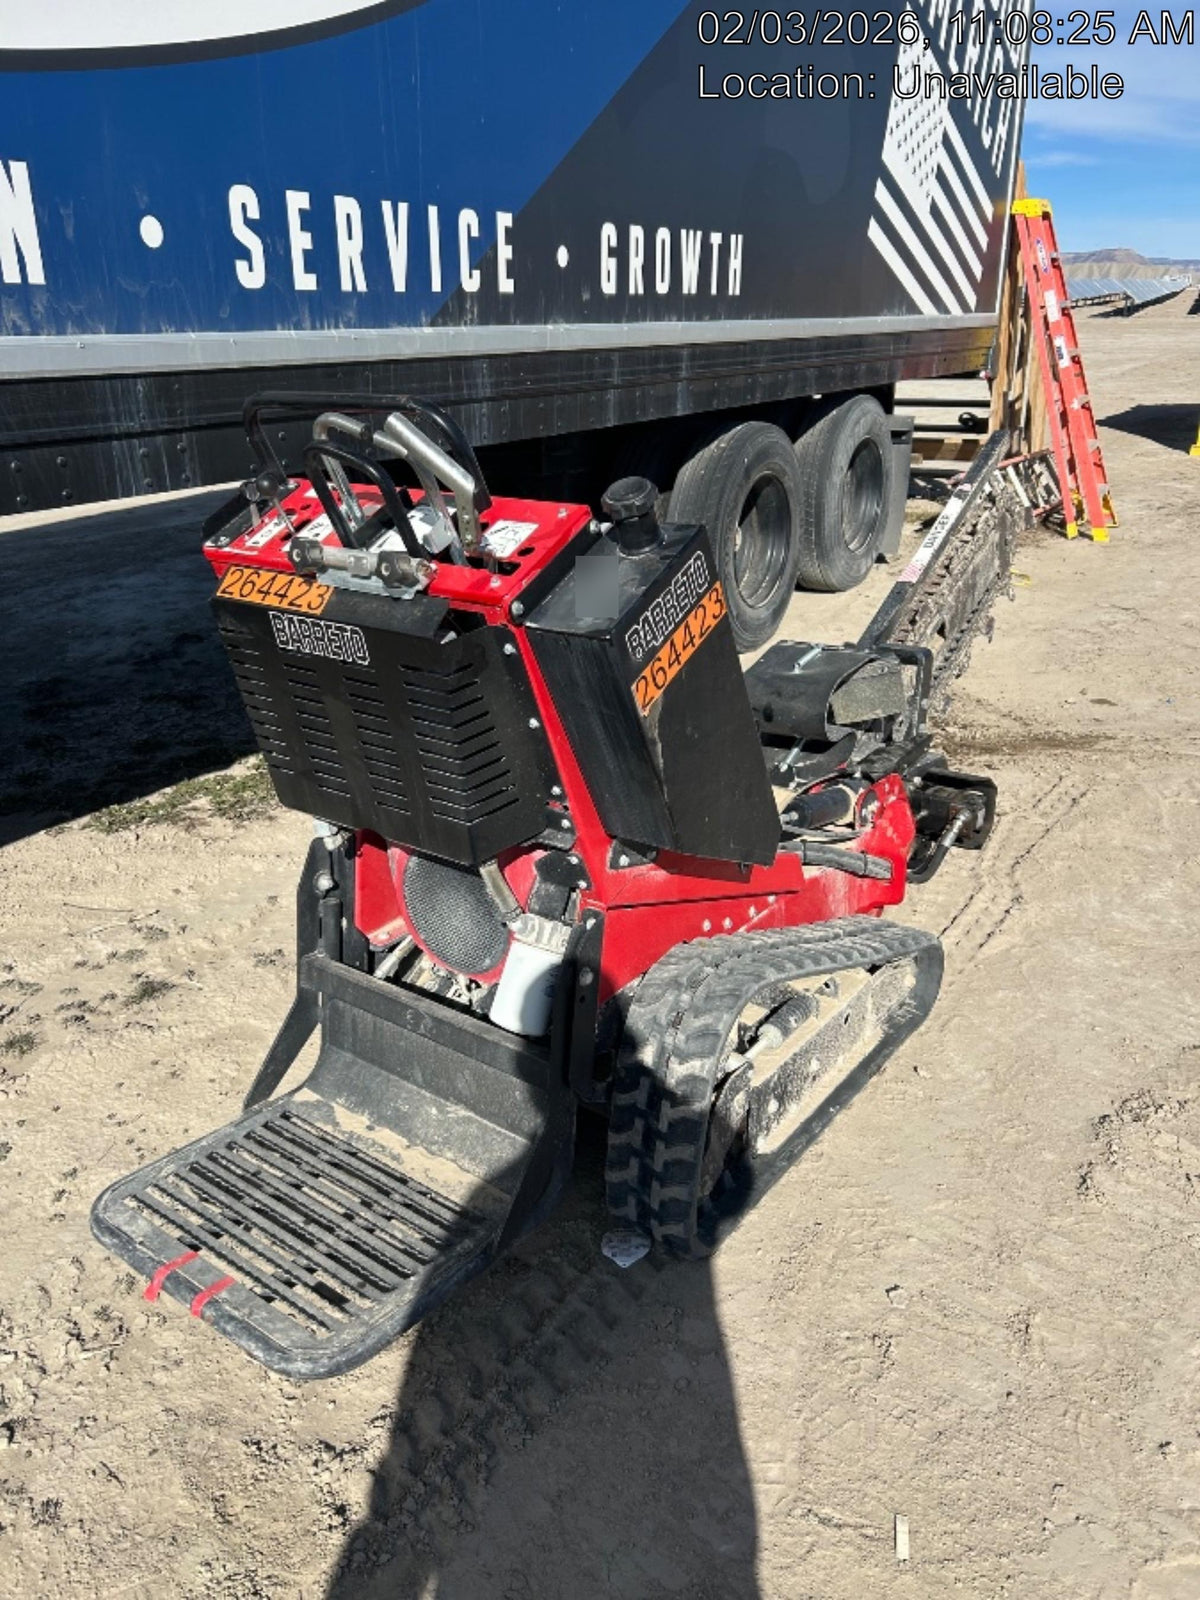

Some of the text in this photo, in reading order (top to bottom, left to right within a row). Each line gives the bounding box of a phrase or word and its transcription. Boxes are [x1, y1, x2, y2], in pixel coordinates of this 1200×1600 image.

[917, 0, 1013, 178] ERICA
[228, 184, 514, 293] SERVICE
[600, 221, 743, 296] GROWTH
[220, 568, 331, 611] 264423
[268, 611, 370, 665] BARRETO
[625, 550, 710, 661] BARRETO
[636, 588, 725, 712] 264423
